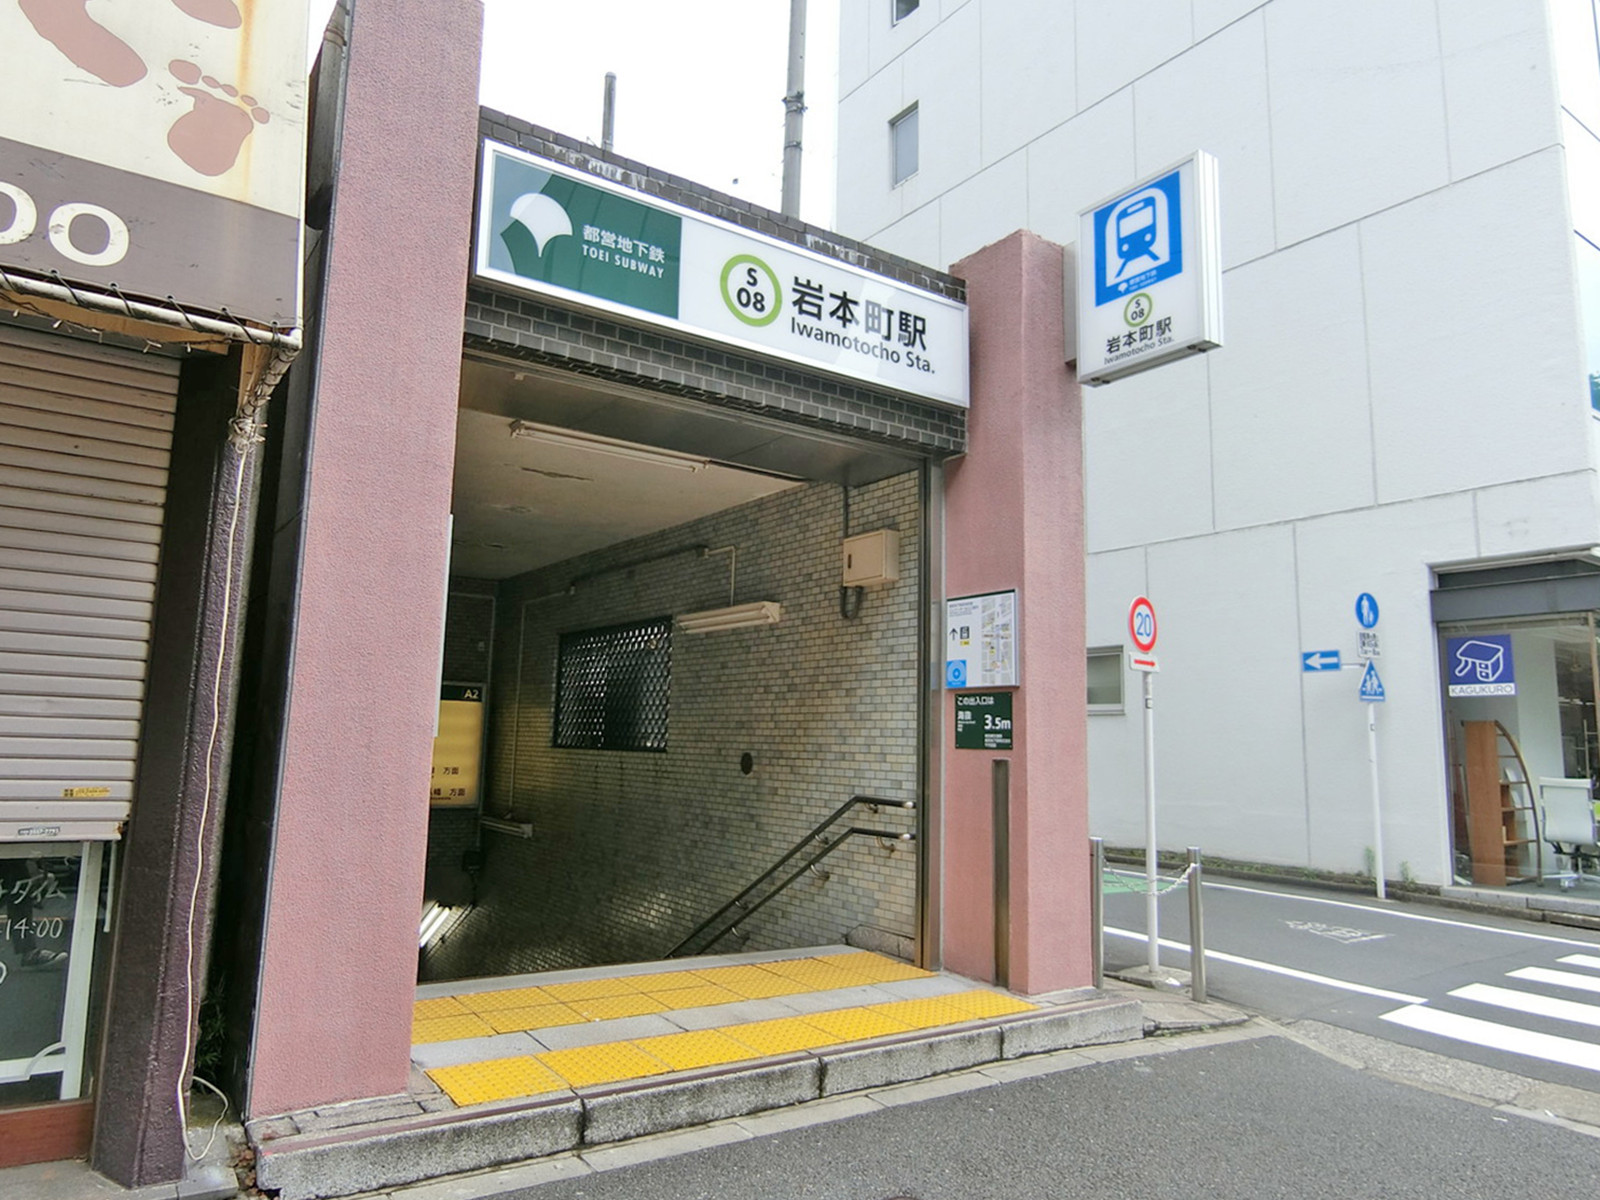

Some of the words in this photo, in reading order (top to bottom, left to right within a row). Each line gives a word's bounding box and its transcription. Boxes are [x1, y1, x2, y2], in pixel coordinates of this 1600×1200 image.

[583, 224, 665, 264] 都営地下鉄
[582, 244, 609, 262] TOEI
[614, 254, 664, 278] SUBWAY
[746, 267, 758, 287] S
[737, 287, 765, 312] 08
[1134, 298, 1141, 309] S
[792, 276, 928, 351] 岩本町駅
[1130, 307, 1145, 321] 08
[791, 317, 901, 364] Iwamotocho
[906, 351, 935, 374] Sta.
[1106, 316, 1172, 355] 岩本町駅
[1104, 341, 1156, 365] Iwamotocho
[1157, 336, 1175, 347] Sta.
[1136, 611, 1152, 637] 20
[464, 689, 479, 699] A2
[1450, 684, 1514, 695] KAGUKURO
[984, 714, 1012, 730] 3.5m
